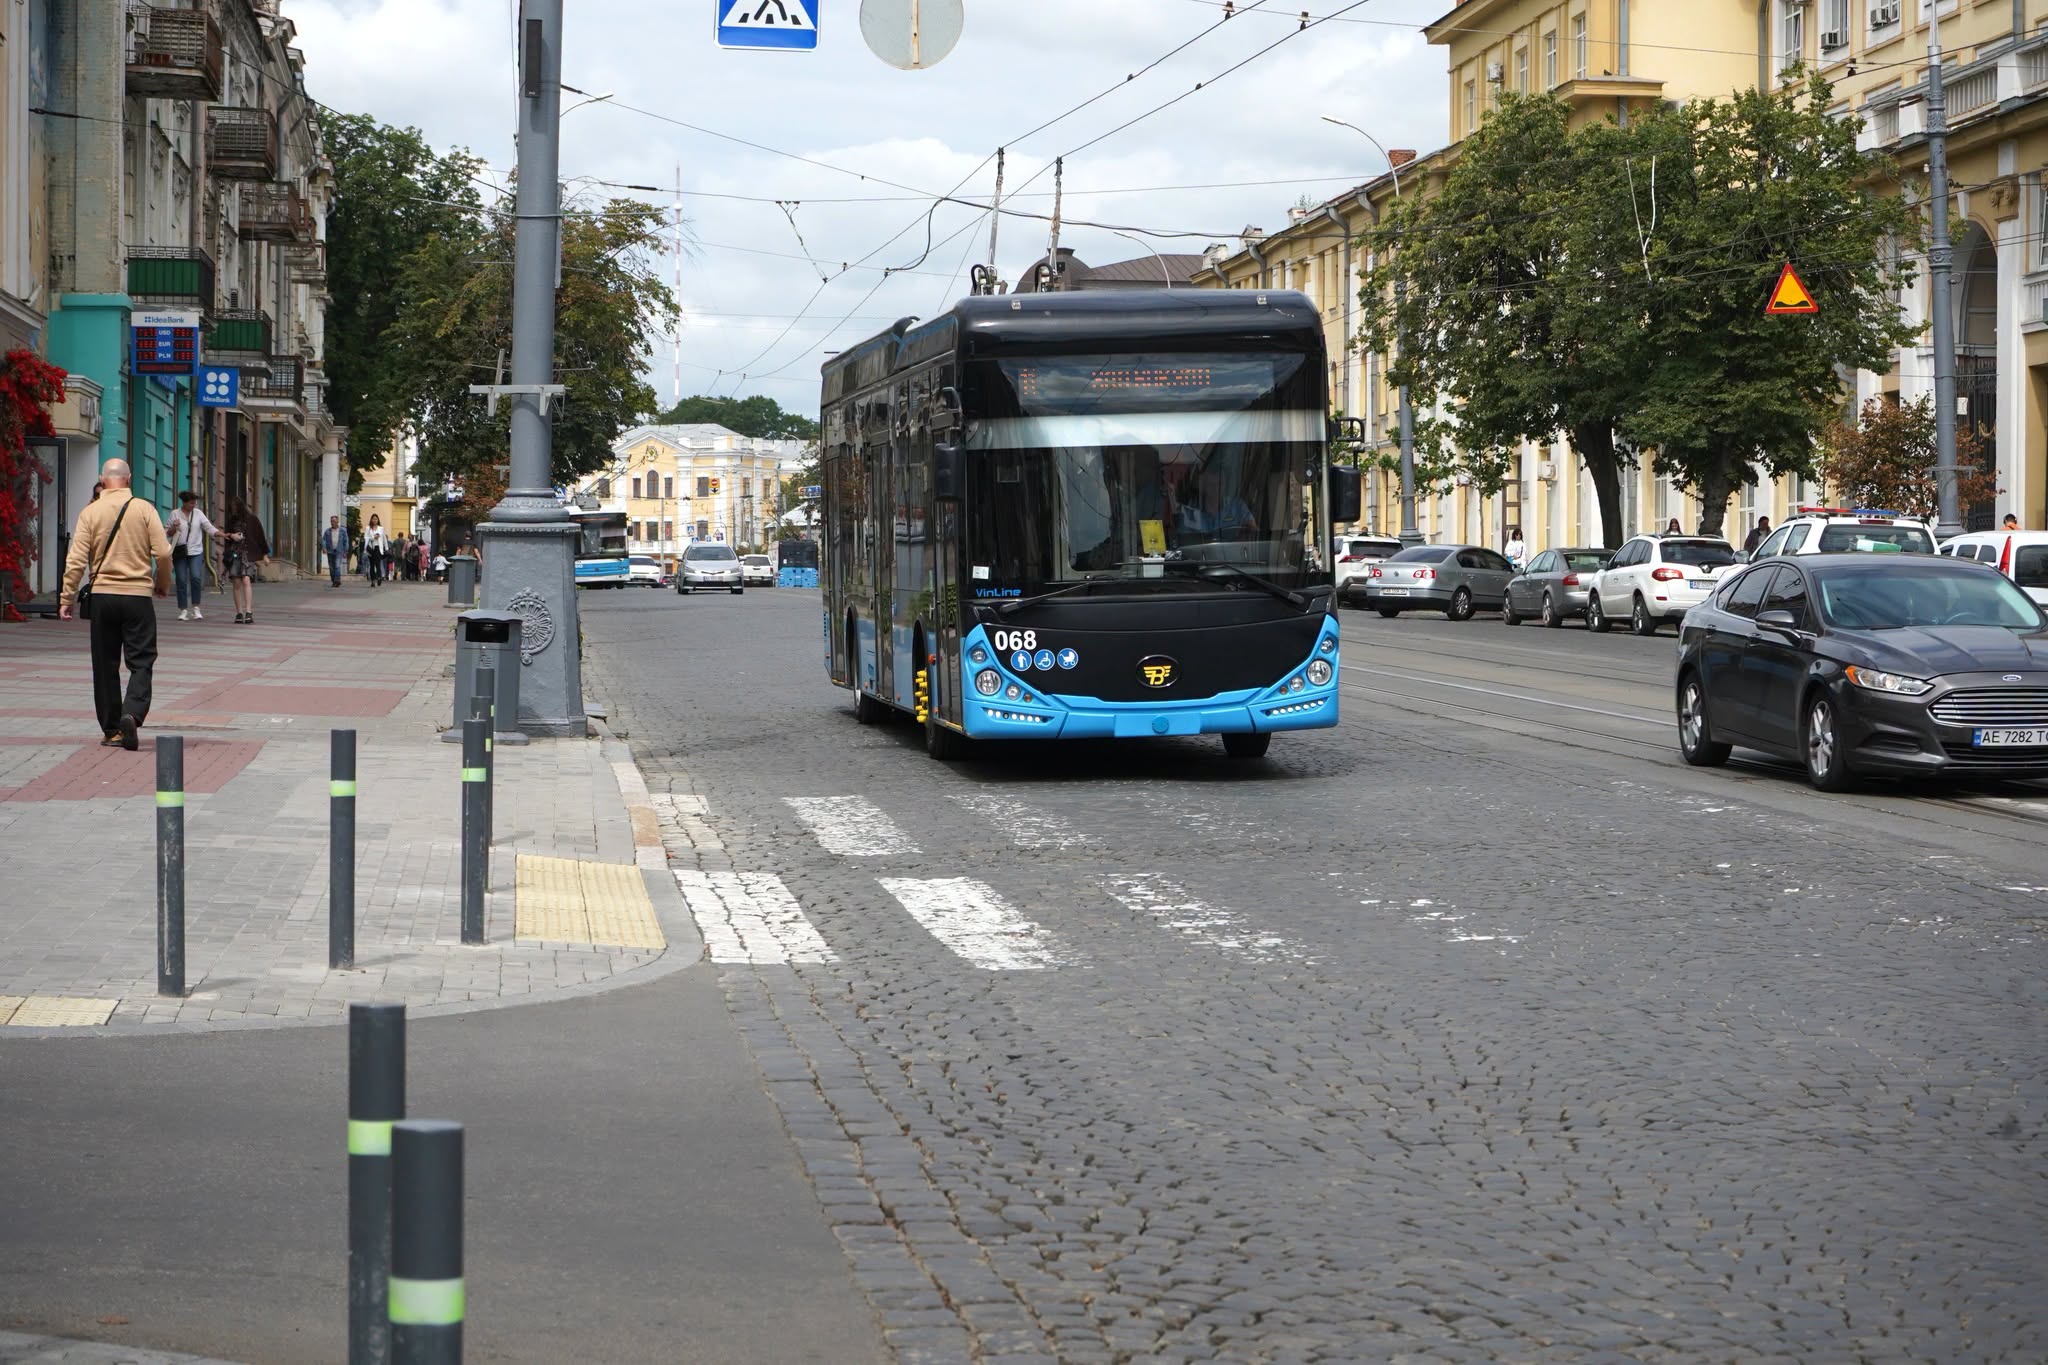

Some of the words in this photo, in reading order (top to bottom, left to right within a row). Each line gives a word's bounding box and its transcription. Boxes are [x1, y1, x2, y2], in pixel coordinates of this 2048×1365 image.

[975, 588, 1022, 597] VinLine
[994, 630, 1037, 651] 068
[1982, 730, 2000, 743] AE
[2004, 730, 2033, 743] 7282
[2036, 730, 2048, 743] T
